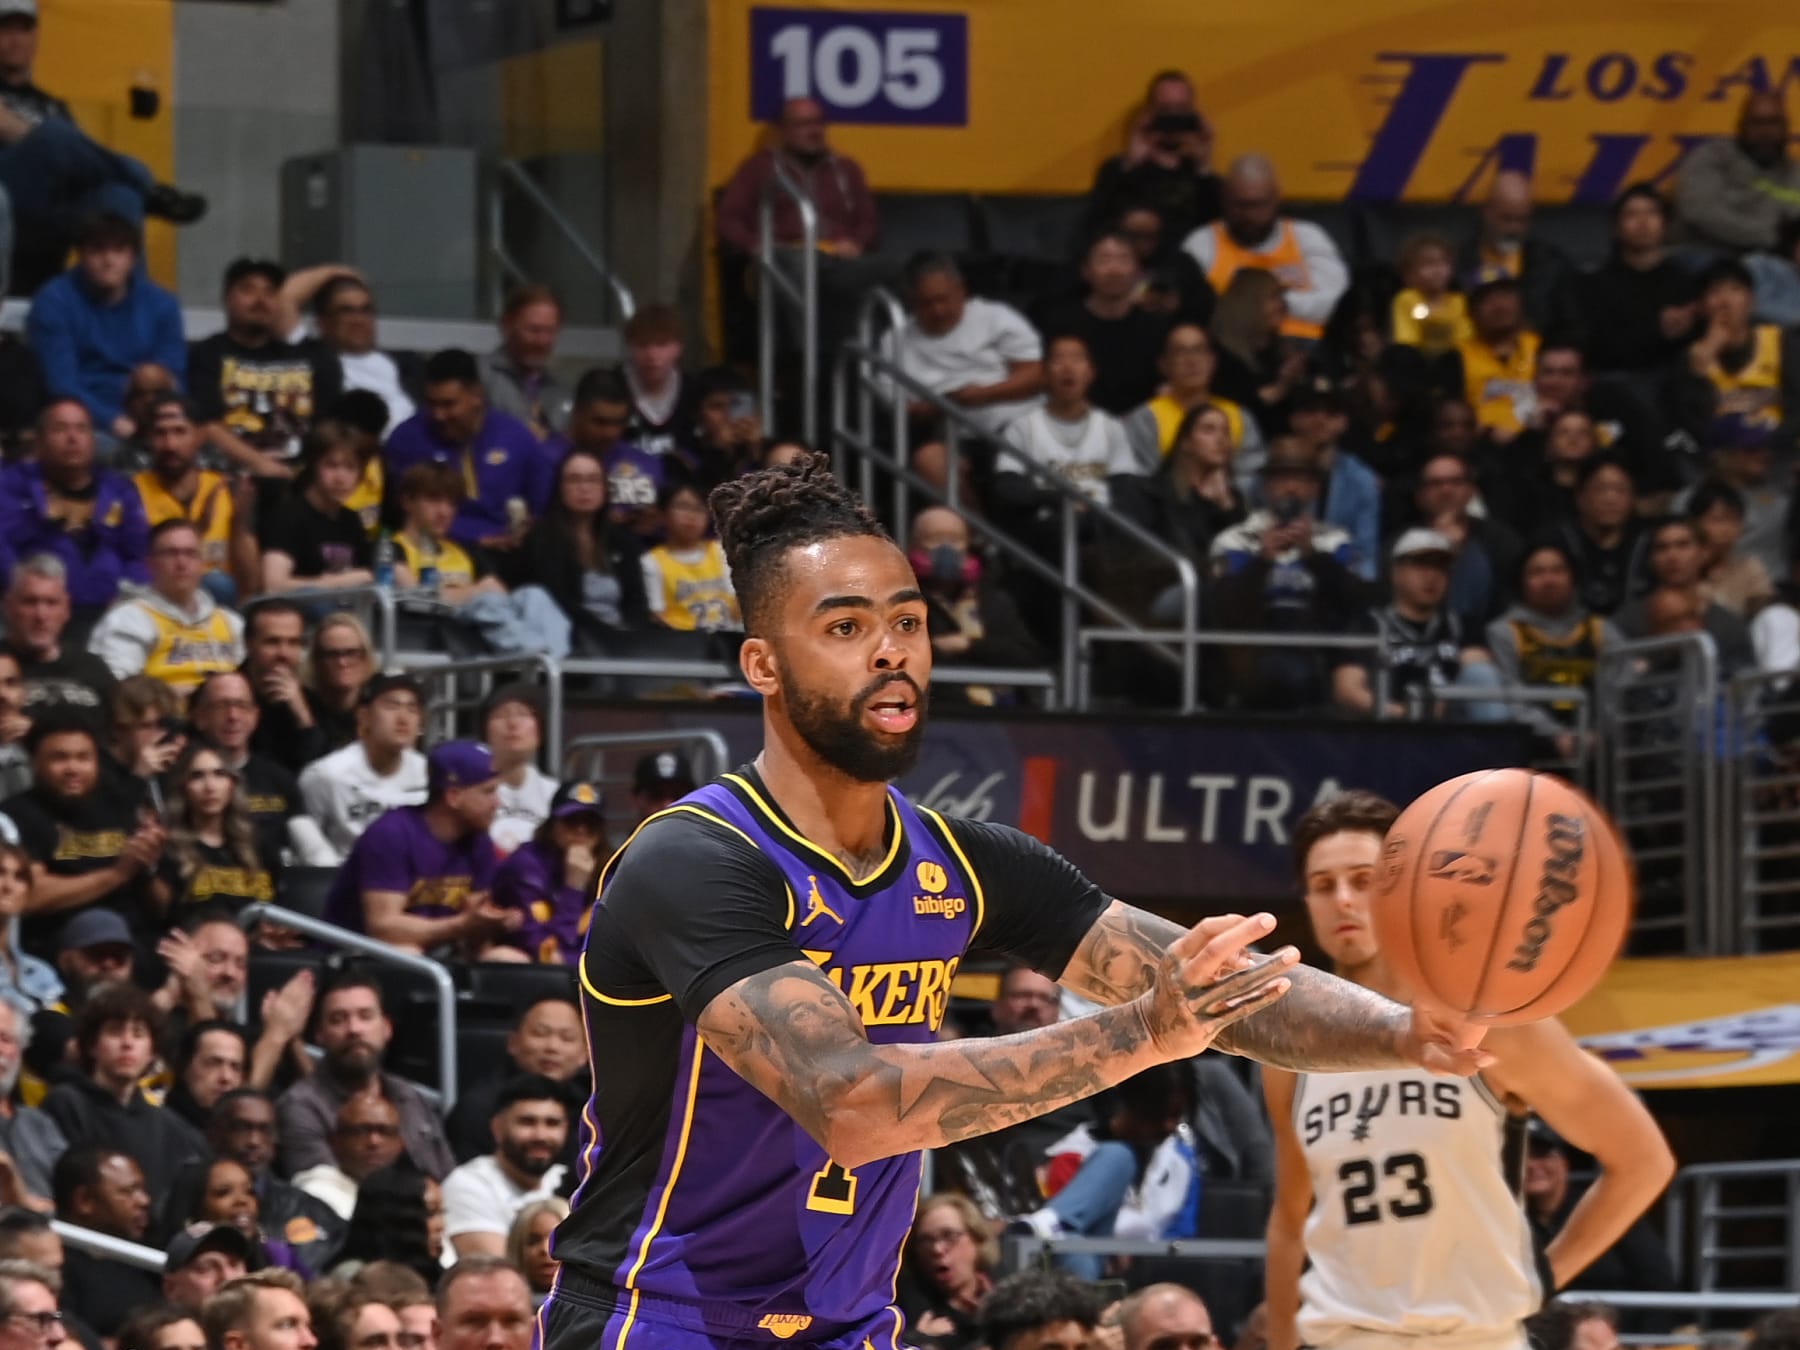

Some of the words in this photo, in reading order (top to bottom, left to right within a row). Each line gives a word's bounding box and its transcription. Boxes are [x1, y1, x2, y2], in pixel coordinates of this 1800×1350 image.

[769, 24, 945, 110] 105
[1529, 53, 1695, 101] LOS
[912, 896, 966, 920] bibigo
[1304, 1080, 1462, 1146] SPURS
[1338, 1153, 1434, 1226] 23
